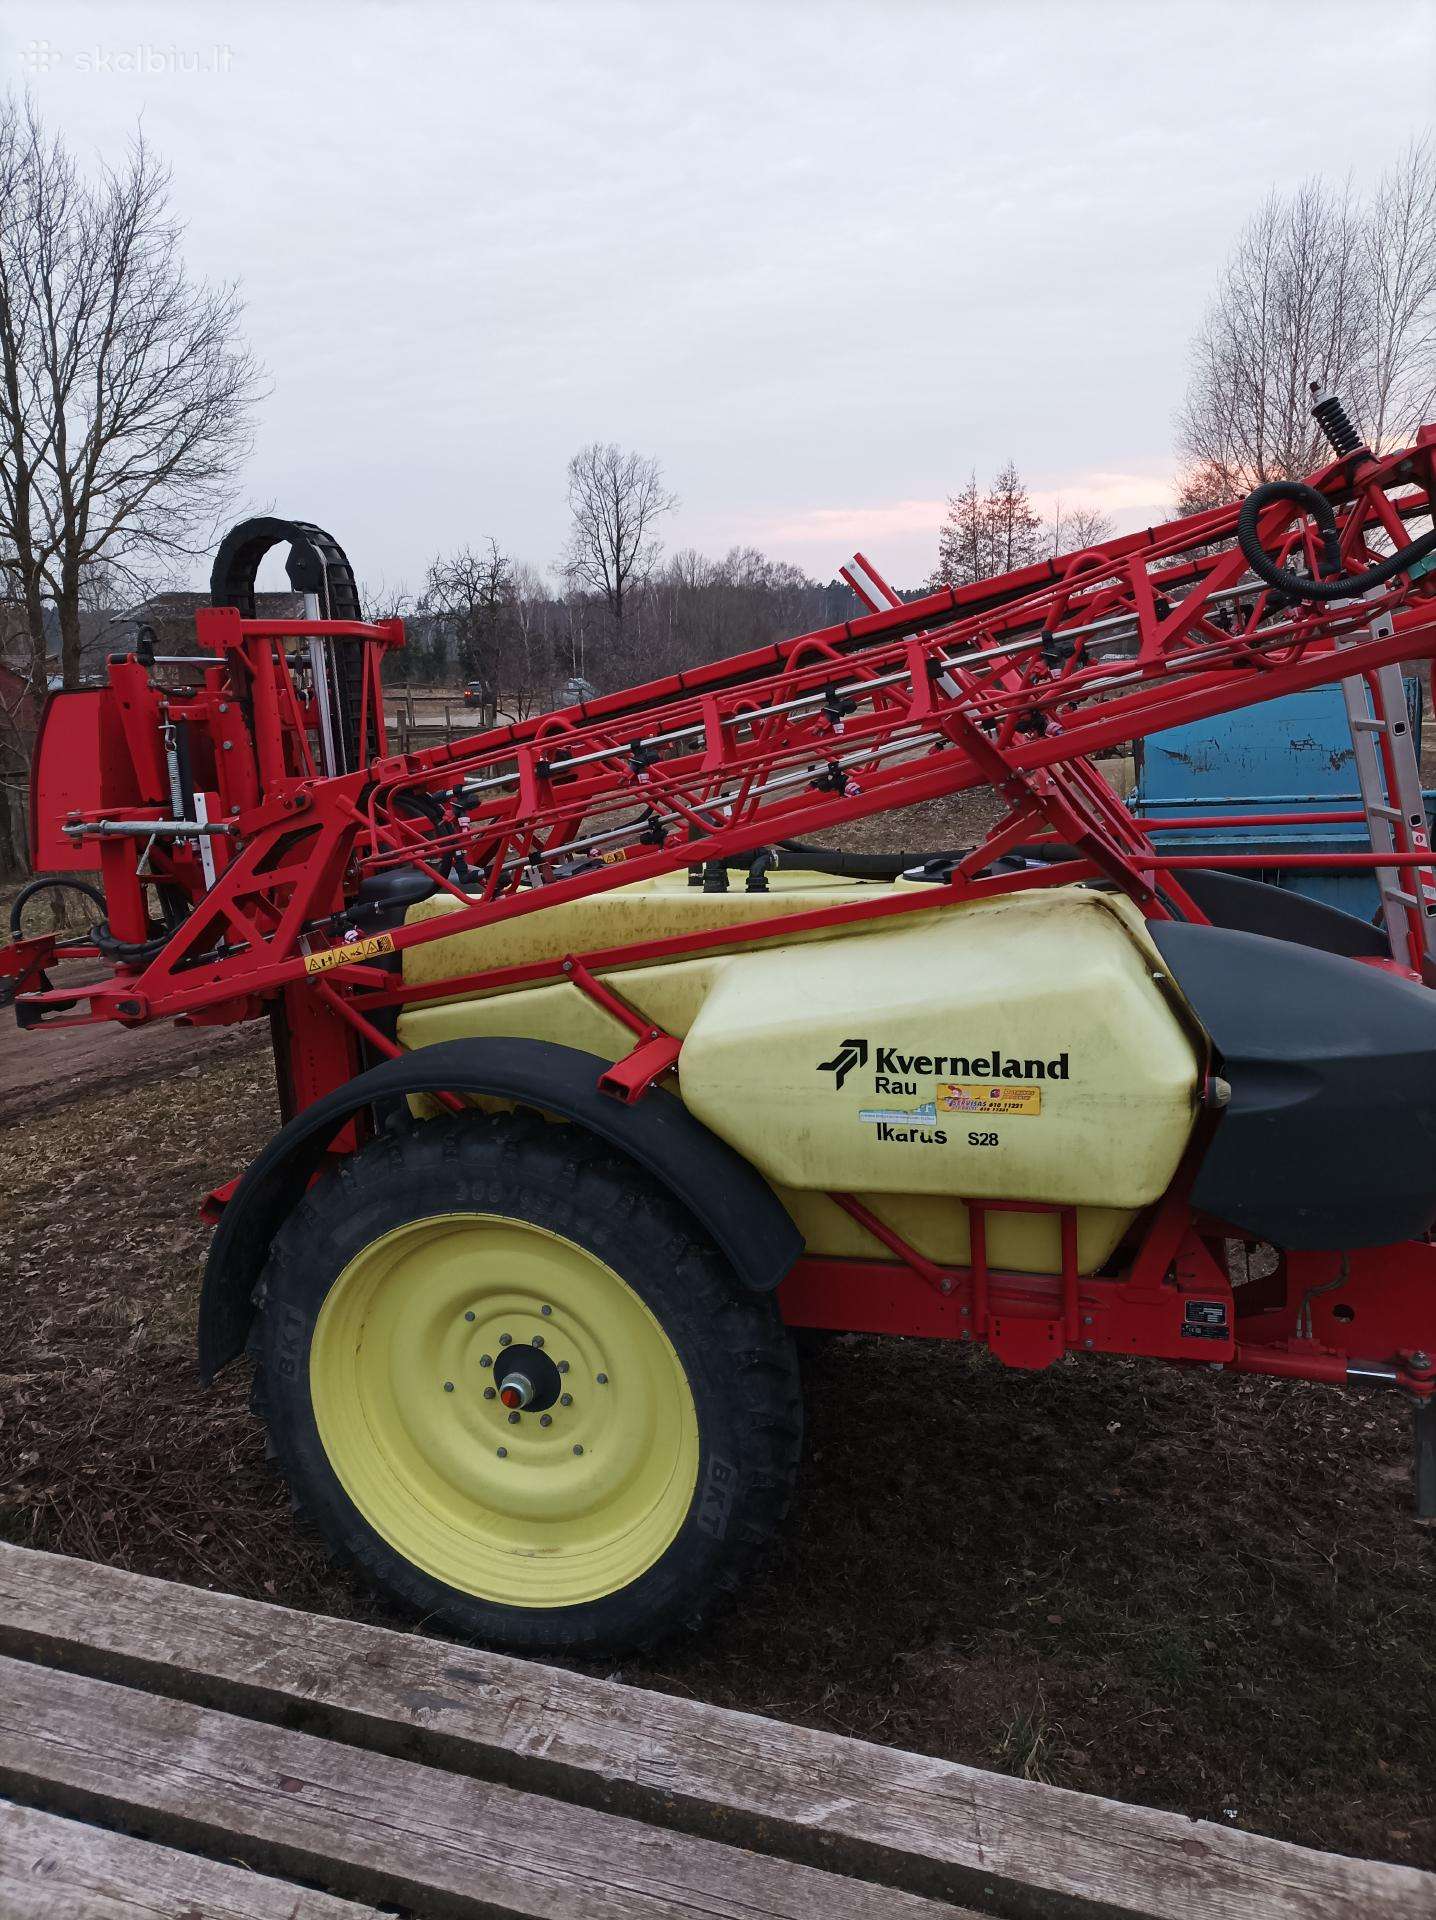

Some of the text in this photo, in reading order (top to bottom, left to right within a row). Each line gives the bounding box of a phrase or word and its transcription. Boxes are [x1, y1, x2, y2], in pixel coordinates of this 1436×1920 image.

[876, 1048, 1070, 1080] Kverneland
[875, 1077, 917, 1095] Rau
[877, 1122, 948, 1145] Ikarus
[967, 1132, 999, 1147] S28
[276, 1307, 303, 1378] BKT
[700, 1460, 733, 1534] BKT
